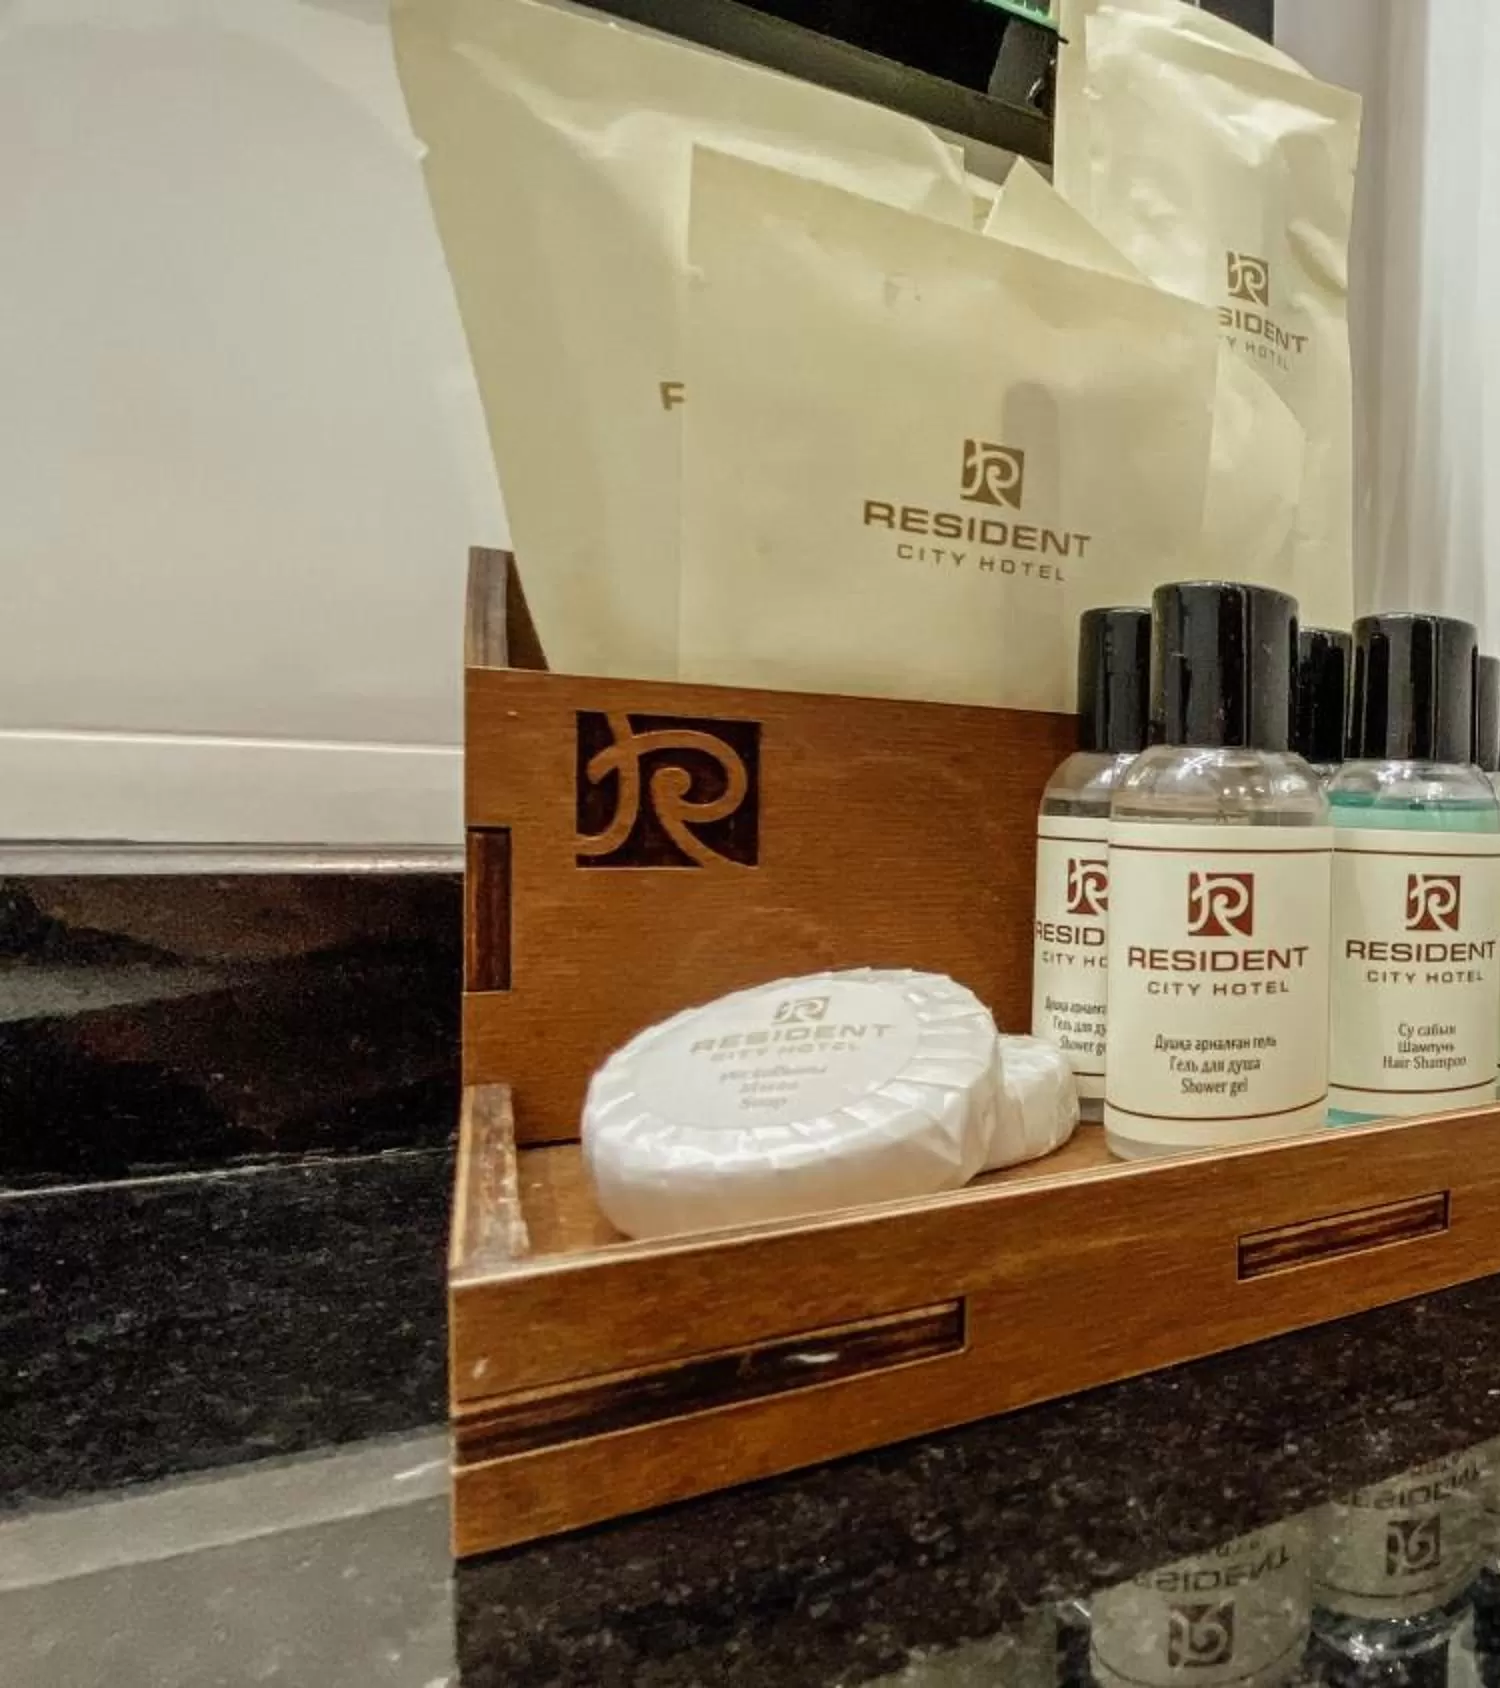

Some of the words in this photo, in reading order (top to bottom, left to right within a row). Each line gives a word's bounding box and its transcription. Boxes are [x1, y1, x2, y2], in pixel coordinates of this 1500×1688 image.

[1217, 305, 1309, 353] SIDENT
[863, 499, 1092, 558] RESIDENT
[897, 543, 966, 568] CITY
[979, 556, 1066, 581] HOTEL
[1034, 920, 1105, 947] RESID
[1042, 950, 1075, 965] CITY
[1128, 946, 1309, 973] RESIDENT
[1345, 939, 1496, 963] RESIDENT
[1147, 980, 1200, 996] CITY
[1212, 980, 1290, 996] HOTEL
[1367, 970, 1416, 984] CITY
[1426, 970, 1483, 984] HOTEL
[690, 1023, 894, 1054] RESIDENT
[1397, 1040, 1455, 1055] Шампунь
[1169, 1055, 1198, 1072] Гель
[1201, 1059, 1225, 1073] для
[1227, 1058, 1262, 1074] душа
[1383, 1055, 1411, 1069] Hair
[1413, 1055, 1467, 1072] Shampoo
[1180, 1077, 1228, 1094] Shower
[1230, 1076, 1249, 1097] gel
